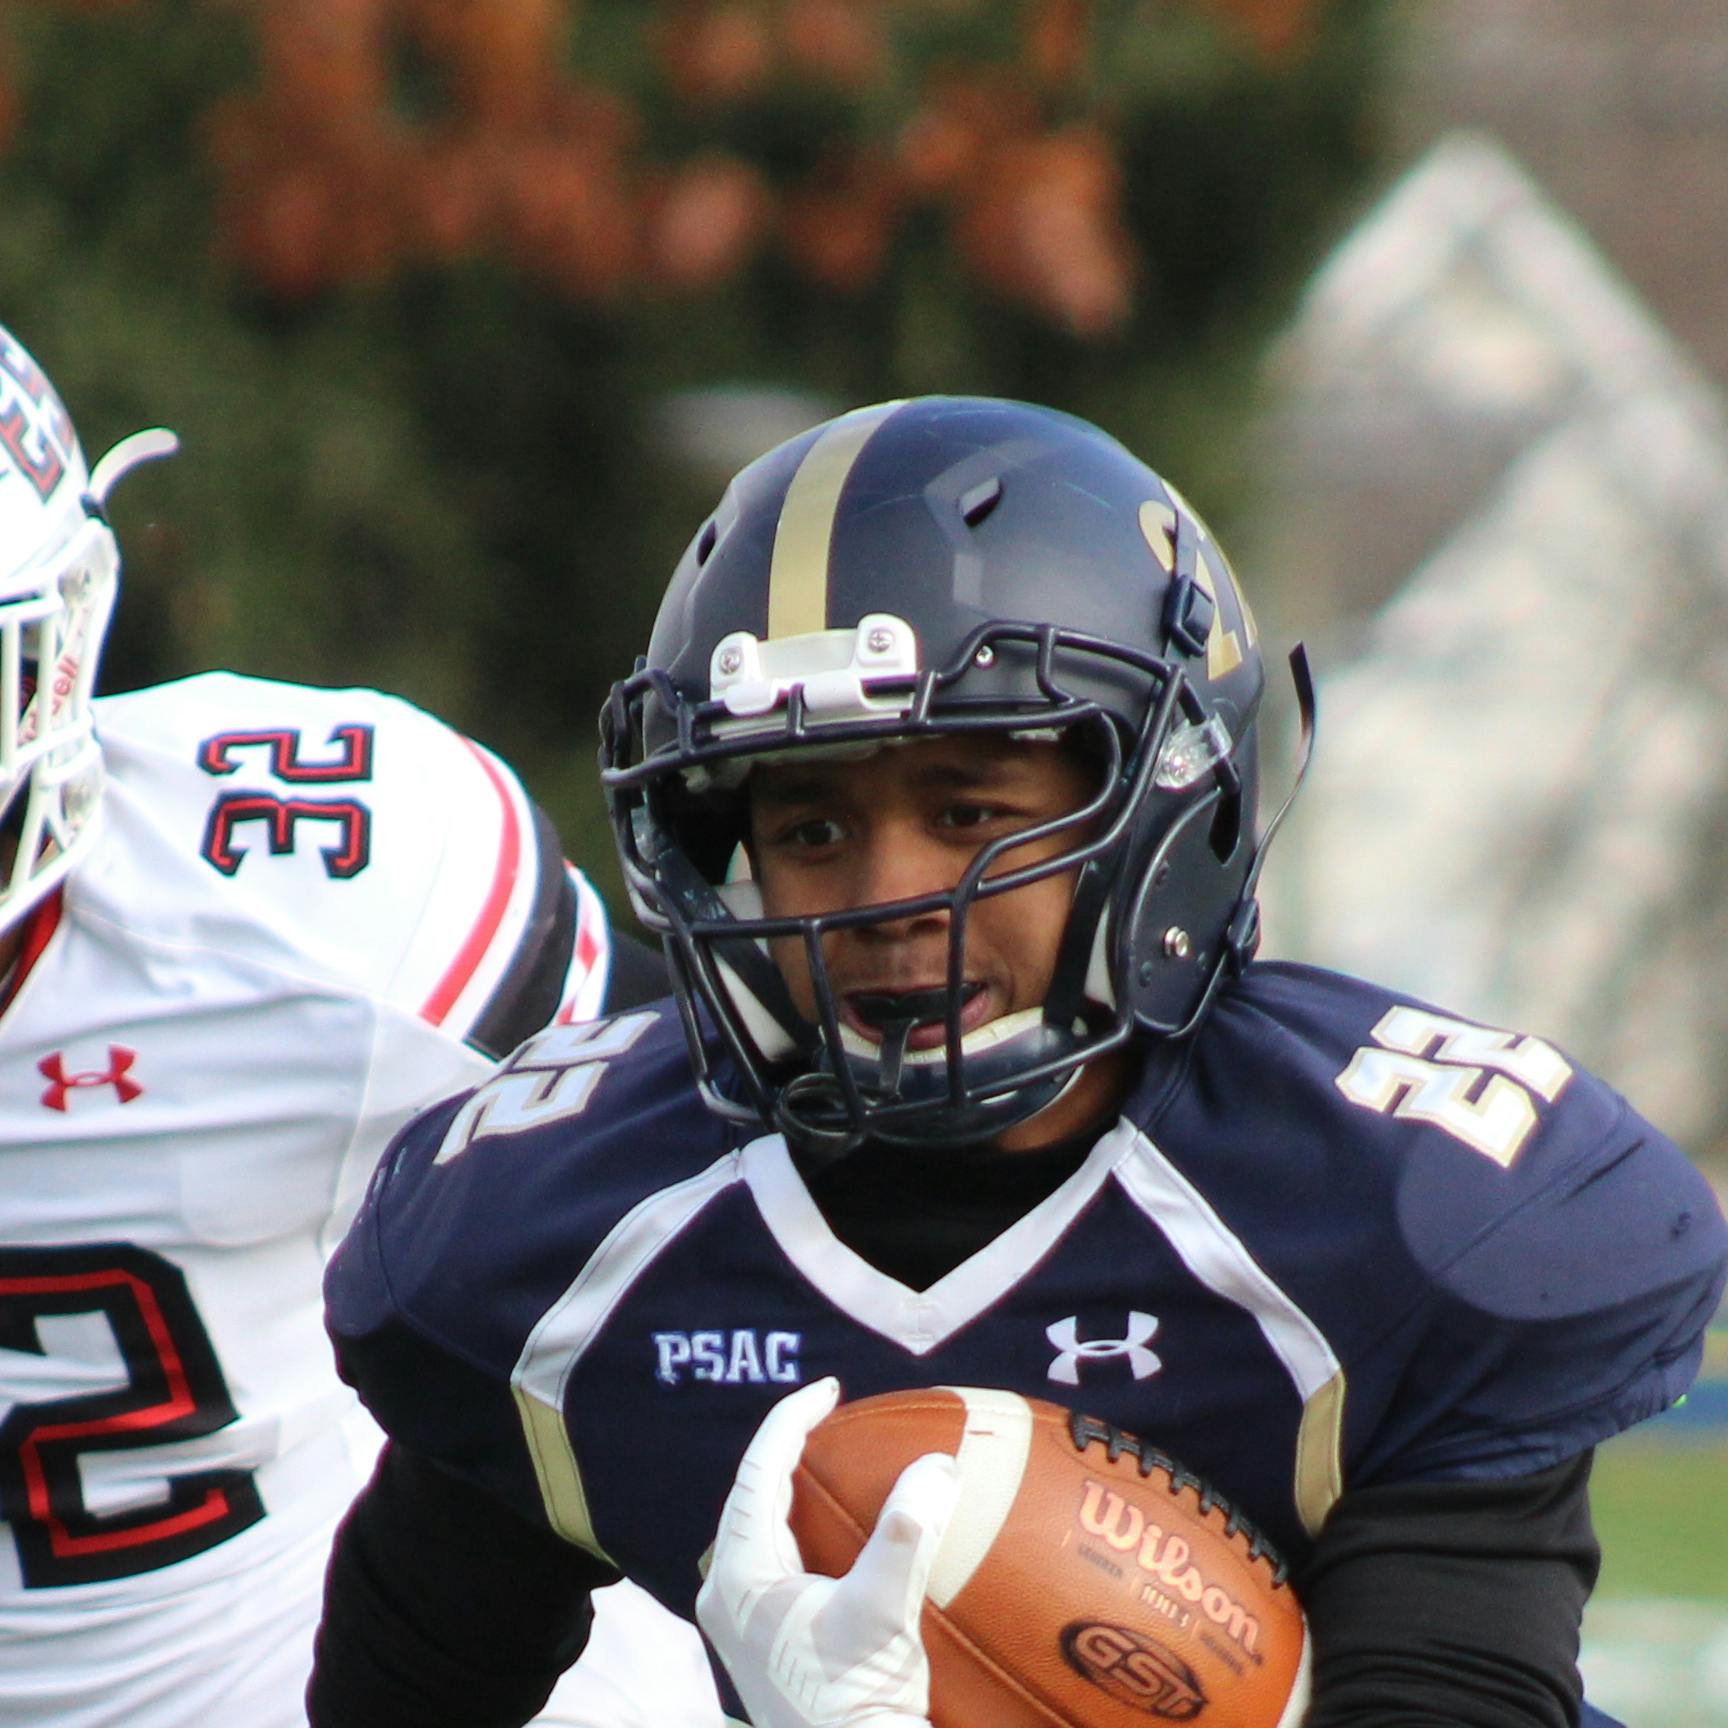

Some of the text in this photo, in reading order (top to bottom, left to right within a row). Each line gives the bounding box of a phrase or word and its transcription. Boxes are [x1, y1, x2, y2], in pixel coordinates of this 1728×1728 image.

[196, 724, 376, 880] 32
[1333, 1003, 1575, 1169] 22
[650, 1328, 802, 1385] PSAC
[1079, 1479, 1261, 1657] Wilson
[1073, 1624, 1210, 1714] GST
